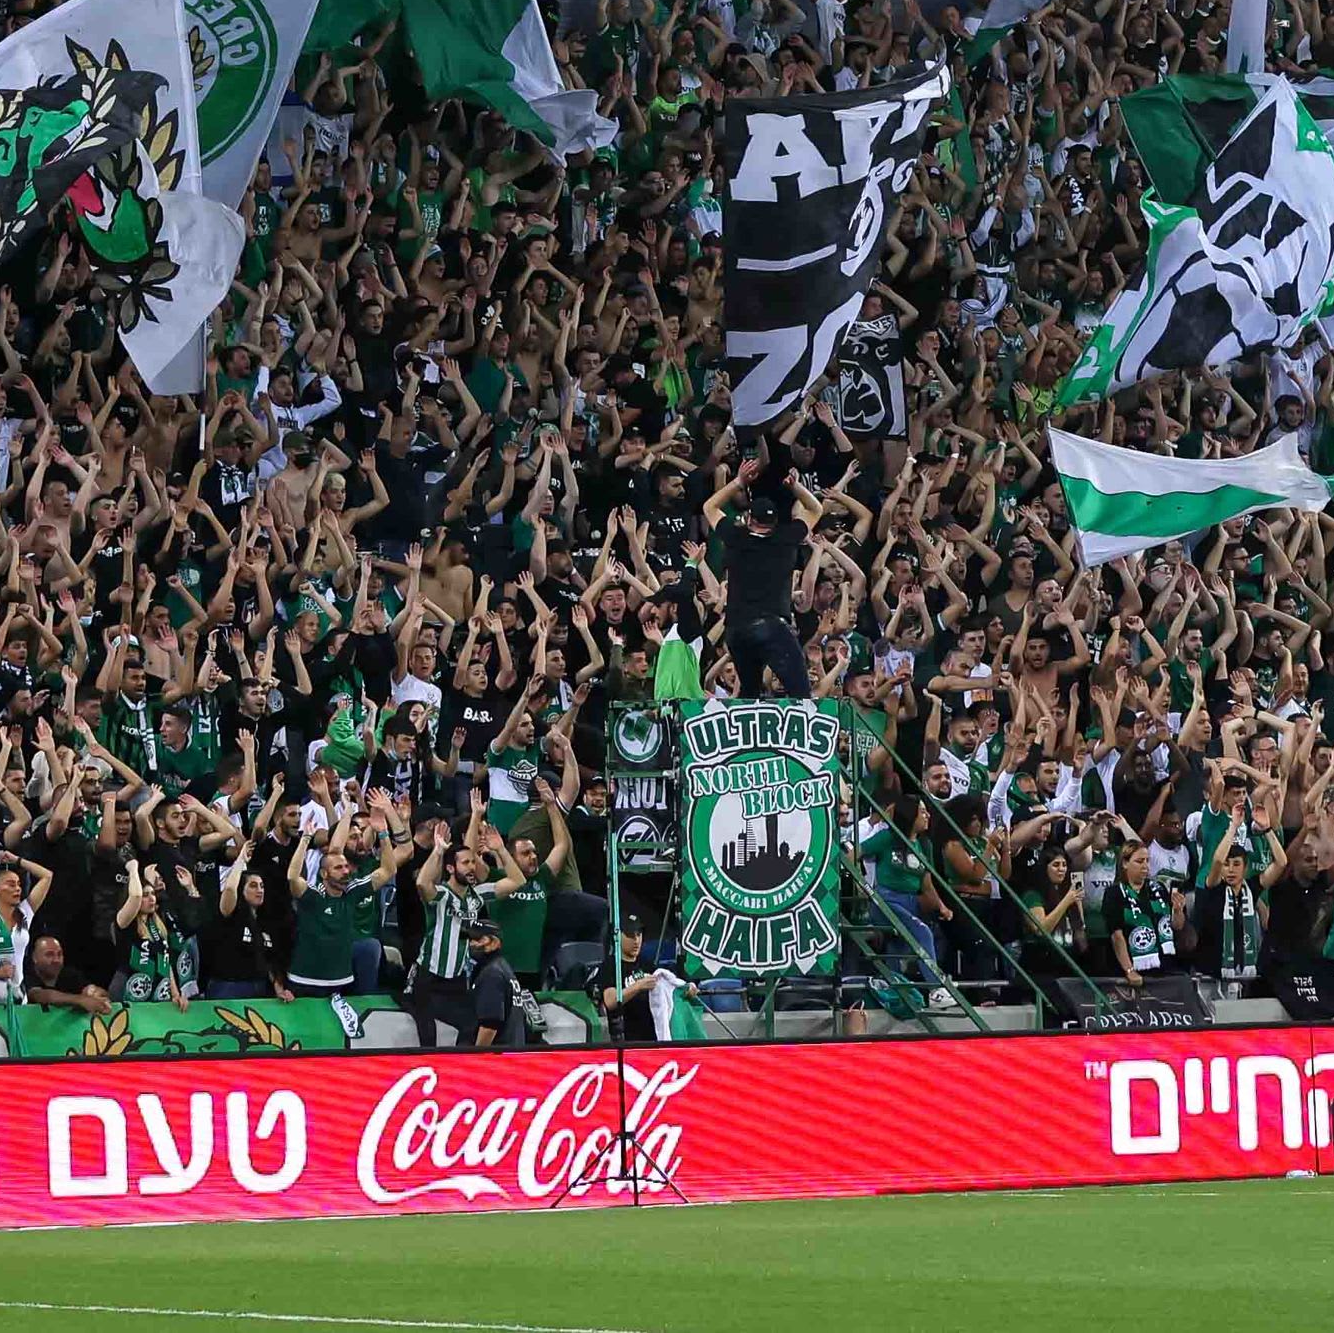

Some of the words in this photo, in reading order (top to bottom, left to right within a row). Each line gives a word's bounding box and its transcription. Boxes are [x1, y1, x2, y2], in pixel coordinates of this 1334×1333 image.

[688, 709, 837, 758] ULTRAS
[690, 757, 789, 796] NORTH
[742, 776, 833, 818] BLOCK
[702, 864, 768, 909] MACCABI
[772, 862, 816, 907] HAIFA
[686, 902, 836, 965] HAIFA
[47, 1089, 308, 1198] טעם
[356, 1059, 699, 1203] Coca-Cola
